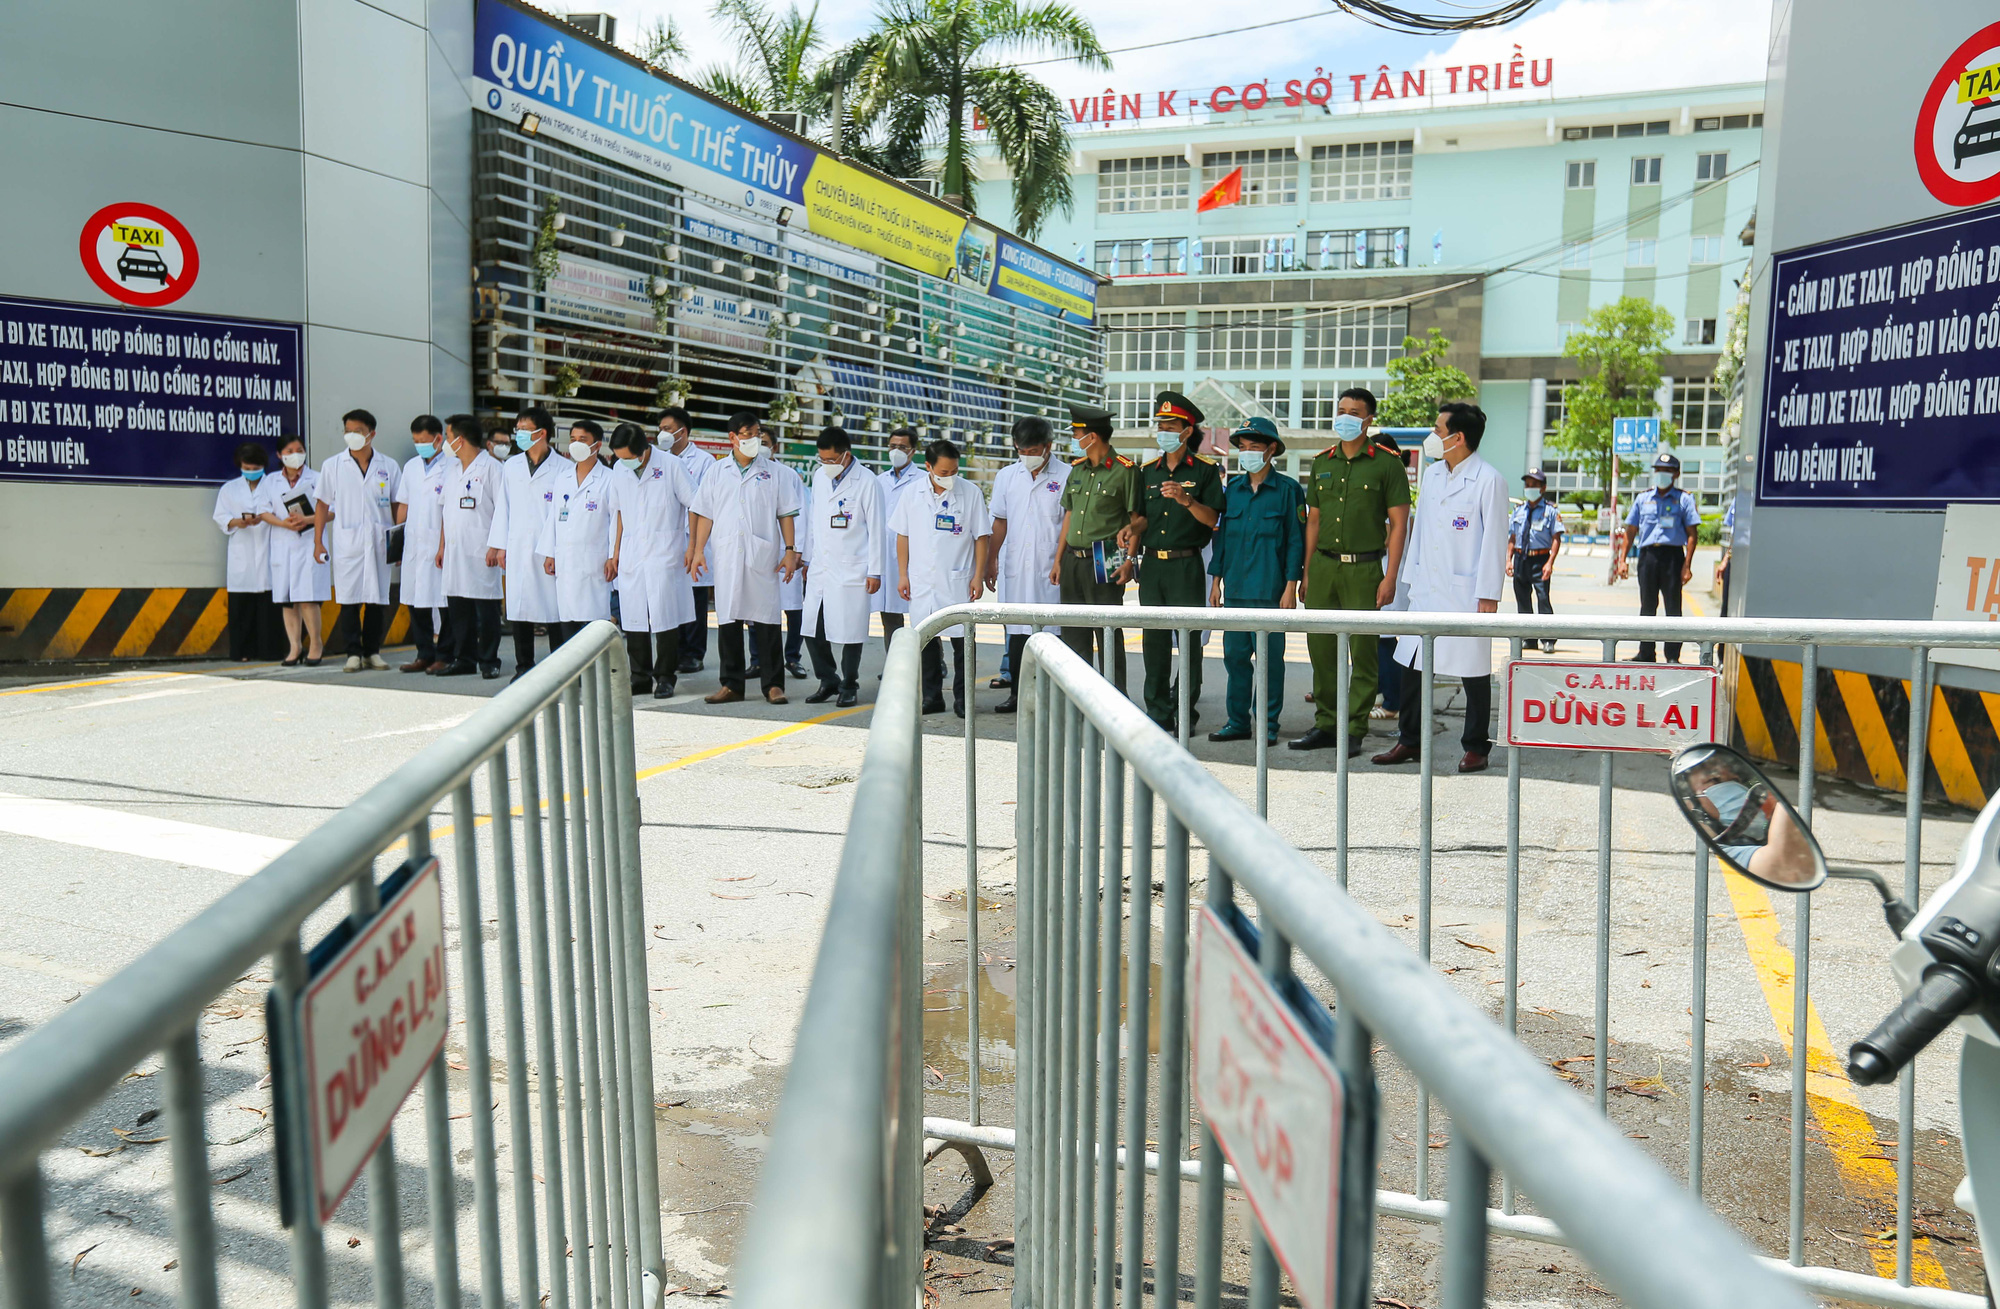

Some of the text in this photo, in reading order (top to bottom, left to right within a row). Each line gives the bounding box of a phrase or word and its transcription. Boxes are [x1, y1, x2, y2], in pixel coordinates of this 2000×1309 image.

[1069, 87, 1141, 129] VIỆN
[1158, 90, 1178, 117] K
[1209, 78, 1268, 113] CƠ
[1283, 66, 1333, 108] SỞ
[1349, 64, 1425, 102] TÂN
[1445, 43, 1553, 94] TRIỀU
[490, 33, 799, 196] QUẦY THUỐC THẾ THỦY
[812, 203, 833, 221] THUỐC
[834, 211, 857, 229] CHUYÊN
[857, 221, 873, 234] KHOA
[877, 227, 894, 244] THUỐC
[815, 179, 848, 205] CHUYÊN
[849, 192, 866, 213] BÁN
[877, 204, 900, 227] THUỐC
[118, 226, 160, 245] TAXI
[1001, 242, 1020, 266] KING
[1787, 270, 1818, 317] CẤM
[1819, 276, 1836, 312] ĐI
[1836, 272, 1857, 309] XE
[1859, 265, 1895, 305] TAXI,
[1899, 256, 1933, 304] HỢP
[1935, 240, 1984, 293] ĐỒNG
[8, 321, 281, 365] ĐI XE TAXI, HỢP ĐỒNG ĐI VÀO CỔNG NÀY.
[1782, 339, 1800, 373] XE
[1803, 334, 1835, 371] TAXI,
[1838, 327, 1868, 373] HỢP
[1870, 313, 1914, 363] ĐỒNG
[1916, 319, 1935, 358] ĐI
[1938, 308, 1971, 355] VÀO
[0, 358, 296, 402] AXI, HỢP ĐỒNG ĐI VÀO CỔNG 2 CHU VĂN AN.
[1778, 383, 1809, 428] CẤM
[1810, 392, 1826, 426] ĐI
[1827, 390, 1847, 424] XE
[1849, 386, 1884, 426] TAXI,
[1888, 380, 1921, 428] HỢP
[1923, 368, 1971, 419] ĐỒNG
[12, 399, 28, 424] ĐI
[31, 401, 51, 425] XE
[53, 402, 91, 430] TAXI,
[94, 403, 124, 433] HỢP
[127, 400, 166, 432] ĐỒNG
[168, 405, 215, 434] KHÔNG
[217, 408, 236, 435] CÓ
[238, 410, 281, 437] KHÁCH
[6, 434, 90, 470] BỆNH VIỆN.
[1773, 440, 1876, 489] VÀO BỆNH VIỆN.
[1565, 673, 1656, 691] C.A.H.N
[1523, 691, 1699, 736] DỪNG LẠI
[1216, 1034, 1294, 1203] STOP
